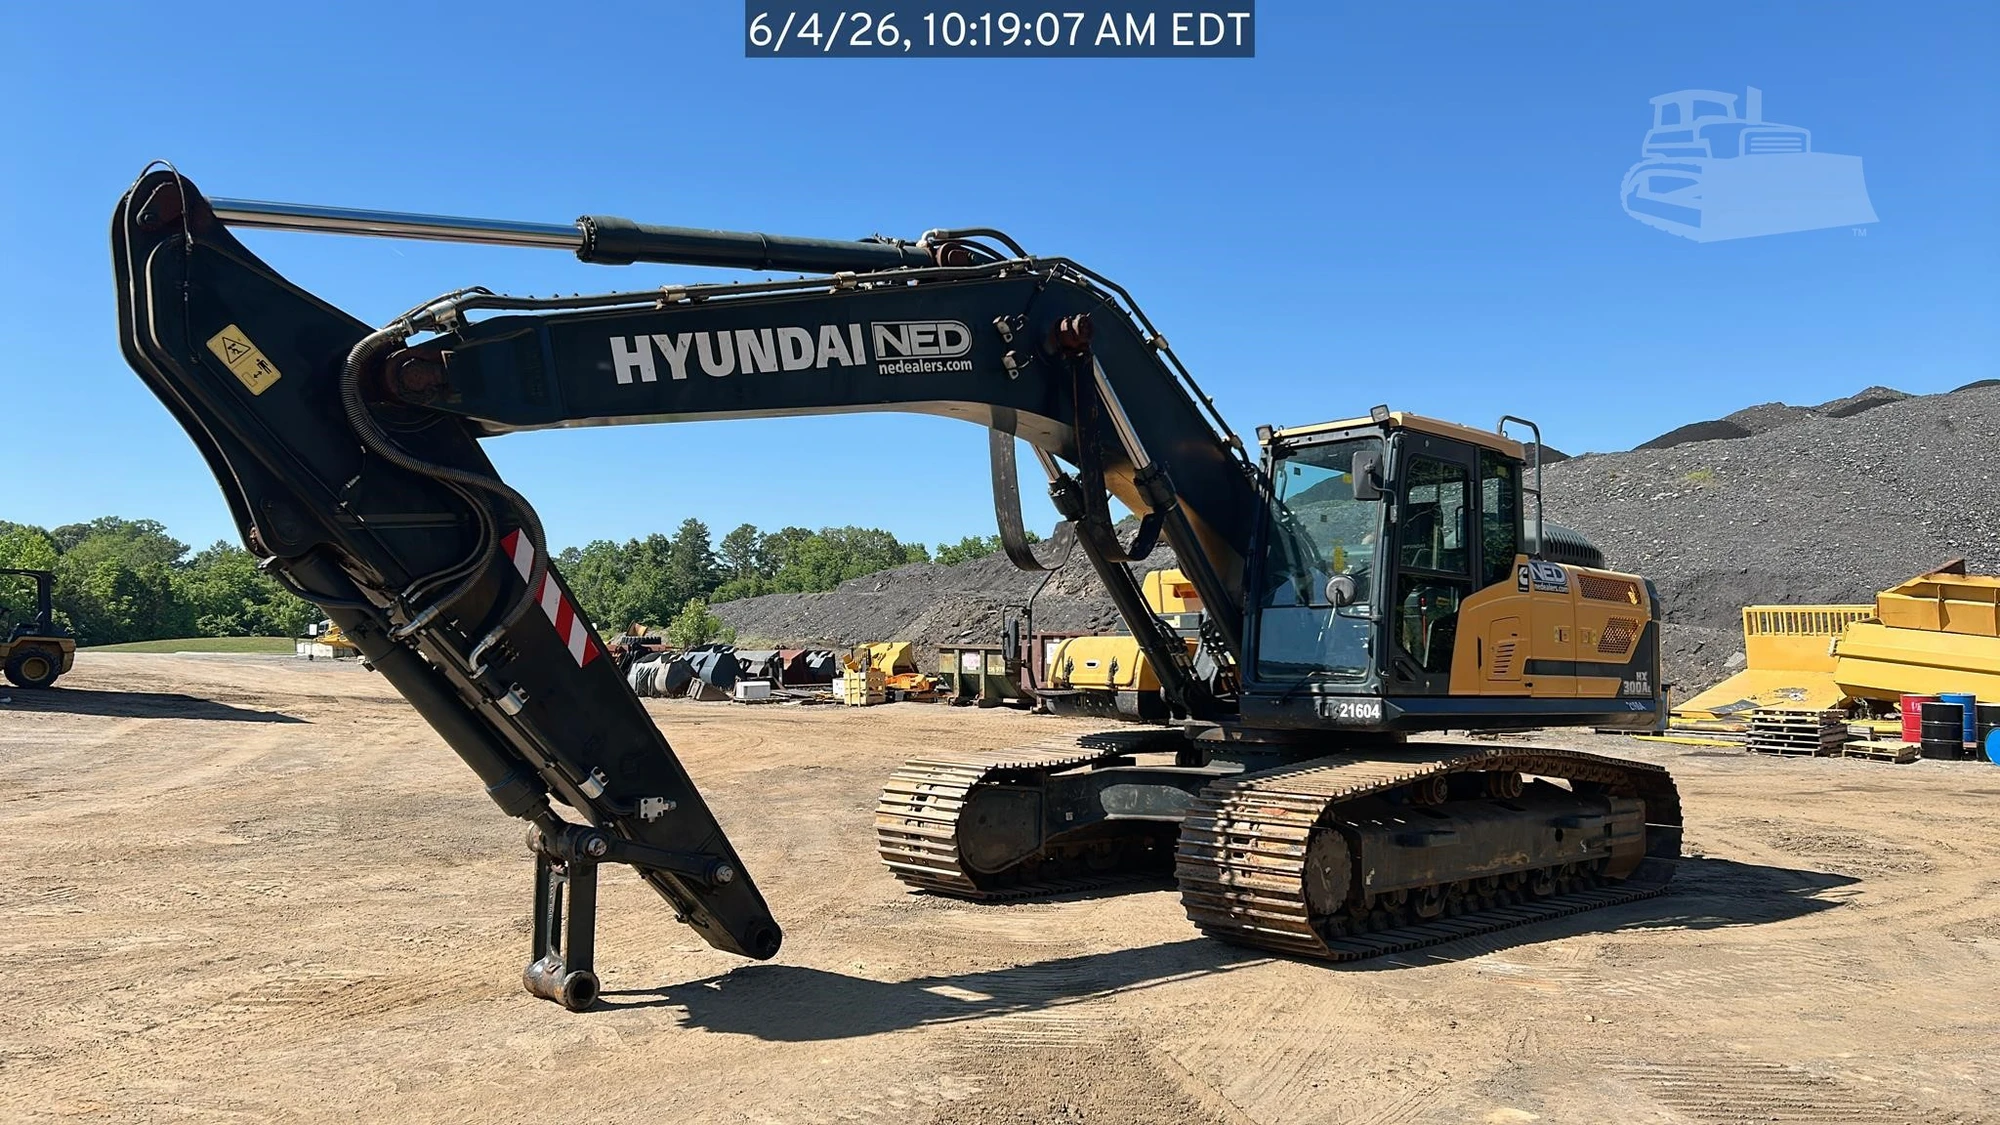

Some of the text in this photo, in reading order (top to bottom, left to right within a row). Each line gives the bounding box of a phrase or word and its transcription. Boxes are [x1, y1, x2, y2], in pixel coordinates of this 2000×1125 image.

[609, 322, 971, 385] HYUNDAI NED
[879, 359, 973, 375] nedealers.com
[1529, 561, 1566, 583] NED
[1636, 671, 1648, 681] HX
[1340, 703, 1381, 719] 21604
